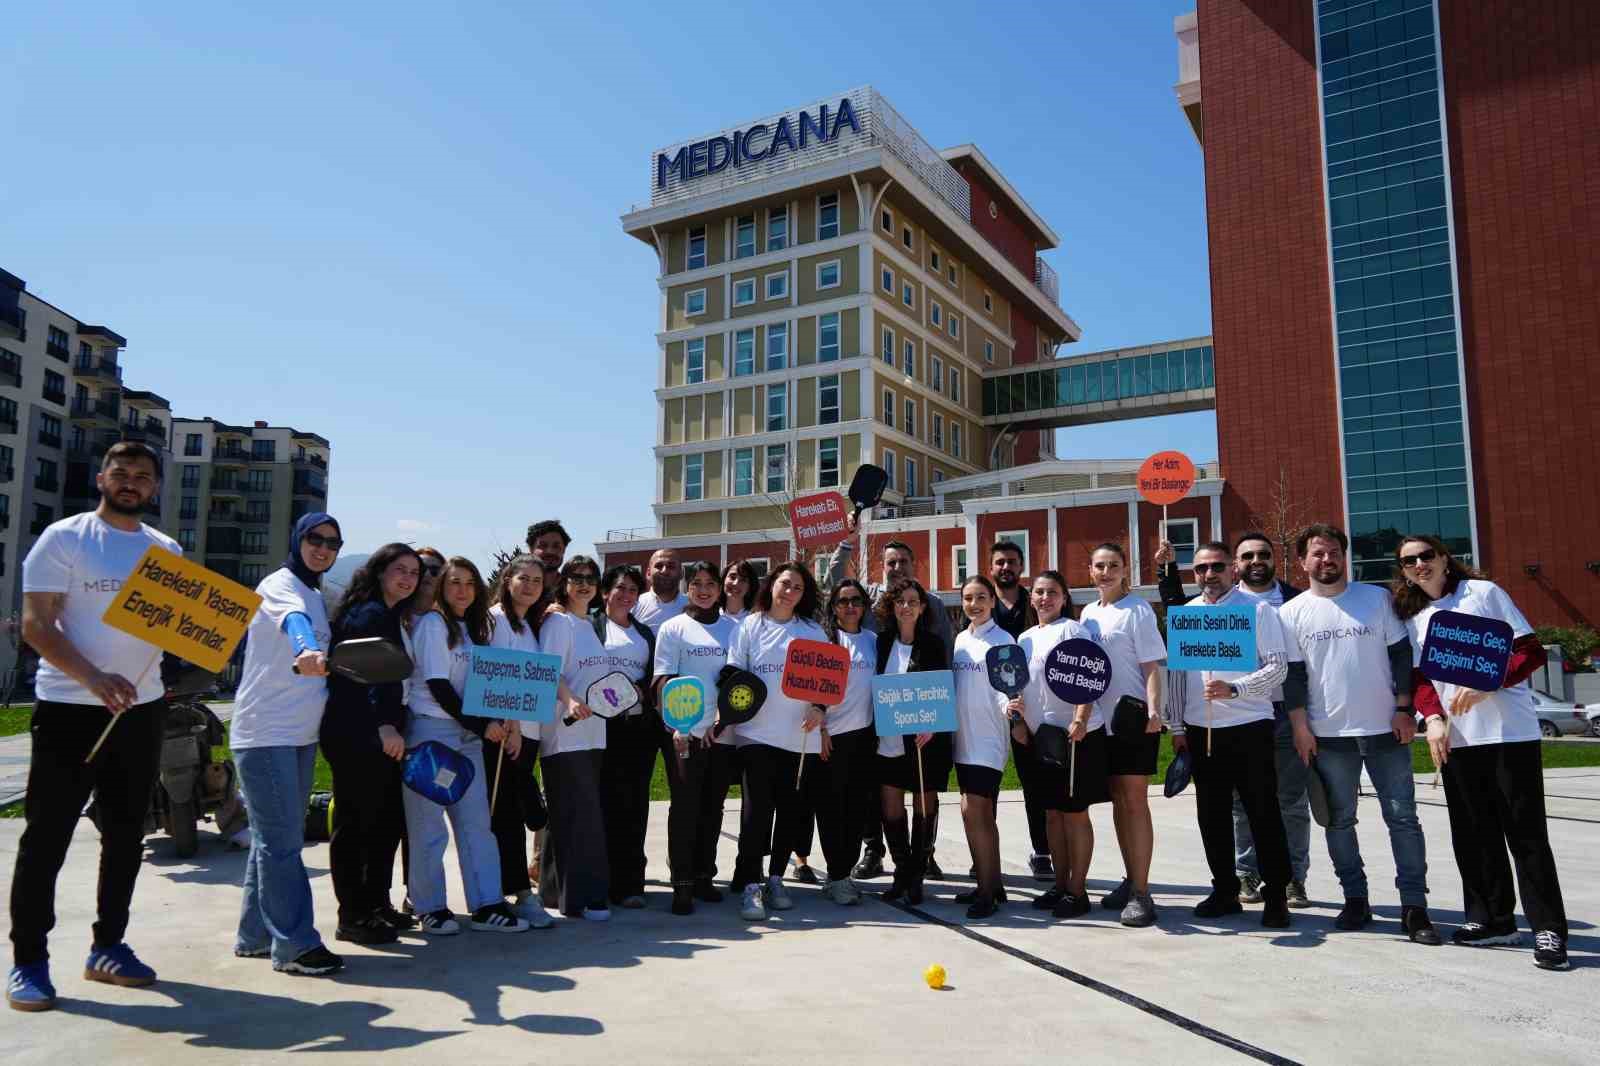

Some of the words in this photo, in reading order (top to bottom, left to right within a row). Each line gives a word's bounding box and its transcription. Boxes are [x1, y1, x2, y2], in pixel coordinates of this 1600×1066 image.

[657, 98, 861, 190] MEDICANA
[795, 502, 826, 518] Hareket
[137, 556, 206, 600] Hareketli
[204, 586, 249, 626] Yaşam,
[123, 590, 175, 628] Enerjik
[1171, 615, 1202, 631] Kalbinin
[1203, 614, 1227, 631] Sesini
[1305, 625, 1371, 641] MEDICANA
[1431, 622, 1480, 645] Harekete
[687, 647, 729, 657] MEDICA
[791, 649, 816, 667] Güçlü
[1180, 640, 1217, 657] Harekete
[1428, 647, 1474, 670] Değişimi
[472, 655, 521, 682] Vazgeçme,
[753, 663, 785, 673] MEDIC
[1056, 650, 1078, 666] Yarın
[1080, 655, 1105, 674] Değil,
[1048, 668, 1075, 684] Şimdi
[1075, 674, 1106, 693] Başla!
[482, 688, 520, 711] Hareket
[522, 693, 539, 712] Et!
[902, 688, 913, 702] Bir
[894, 711, 918, 728] Sporu
